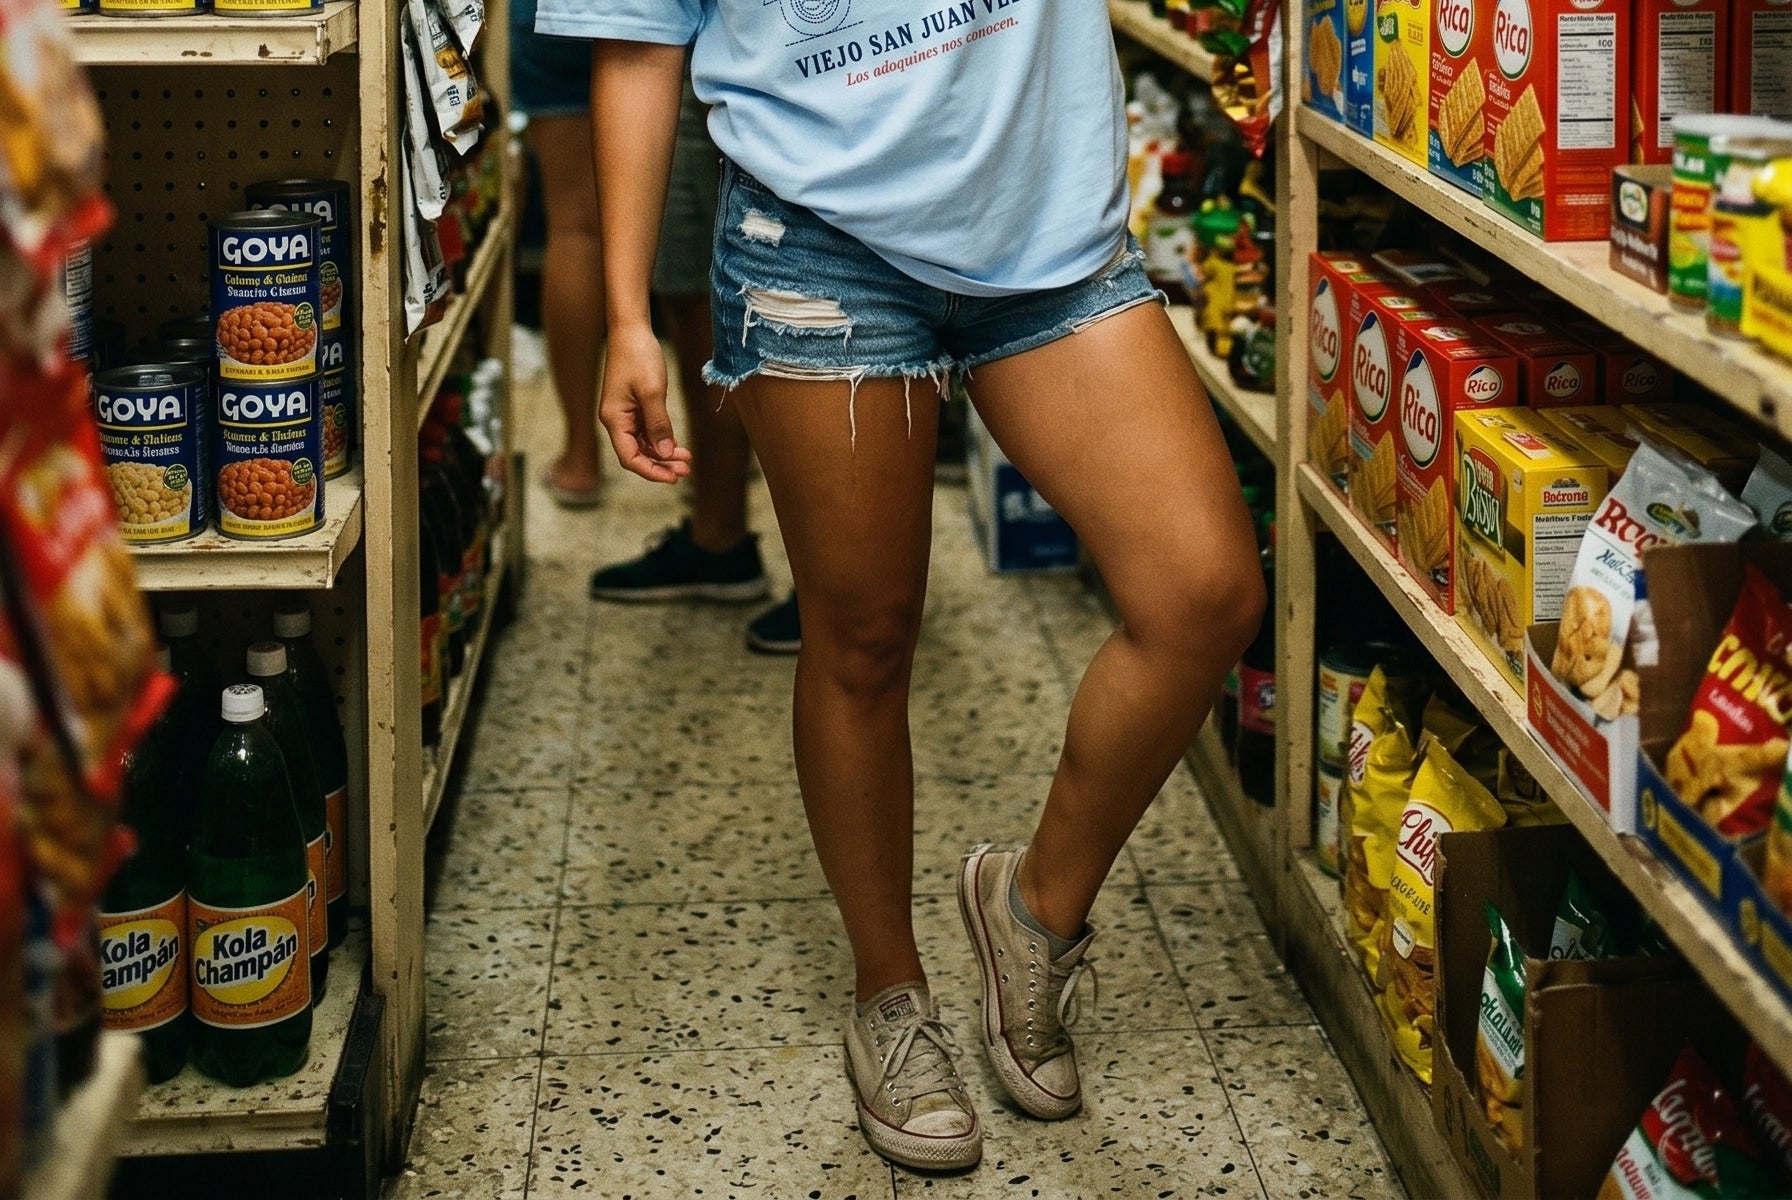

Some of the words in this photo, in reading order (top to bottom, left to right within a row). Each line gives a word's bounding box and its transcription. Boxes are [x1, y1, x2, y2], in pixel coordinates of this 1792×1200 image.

[794, 41, 863, 79] VIEJO
[868, 23, 914, 57] SAN
[921, 0, 977, 39] JUAN
[846, 71, 870, 87] Los
[873, 46, 939, 78] adoquines
[940, 37, 963, 53] nos
[966, 16, 1019, 44] conocen.
[1495, 10, 1529, 57] Rica
[222, 234, 308, 265] GOYA
[1312, 310, 1337, 359] Rica
[1355, 343, 1386, 399] Rica
[1466, 379, 1498, 394] Rica
[1546, 375, 1579, 392] Rica
[1624, 372, 1655, 388] Rica
[98, 394, 181, 423] GOYA
[222, 390, 307, 421] GOYA
[1403, 383, 1437, 445] Rica
[102, 935, 180, 990] ampán
[195, 934, 297, 986] Champán
[213, 927, 267, 961] Kola
